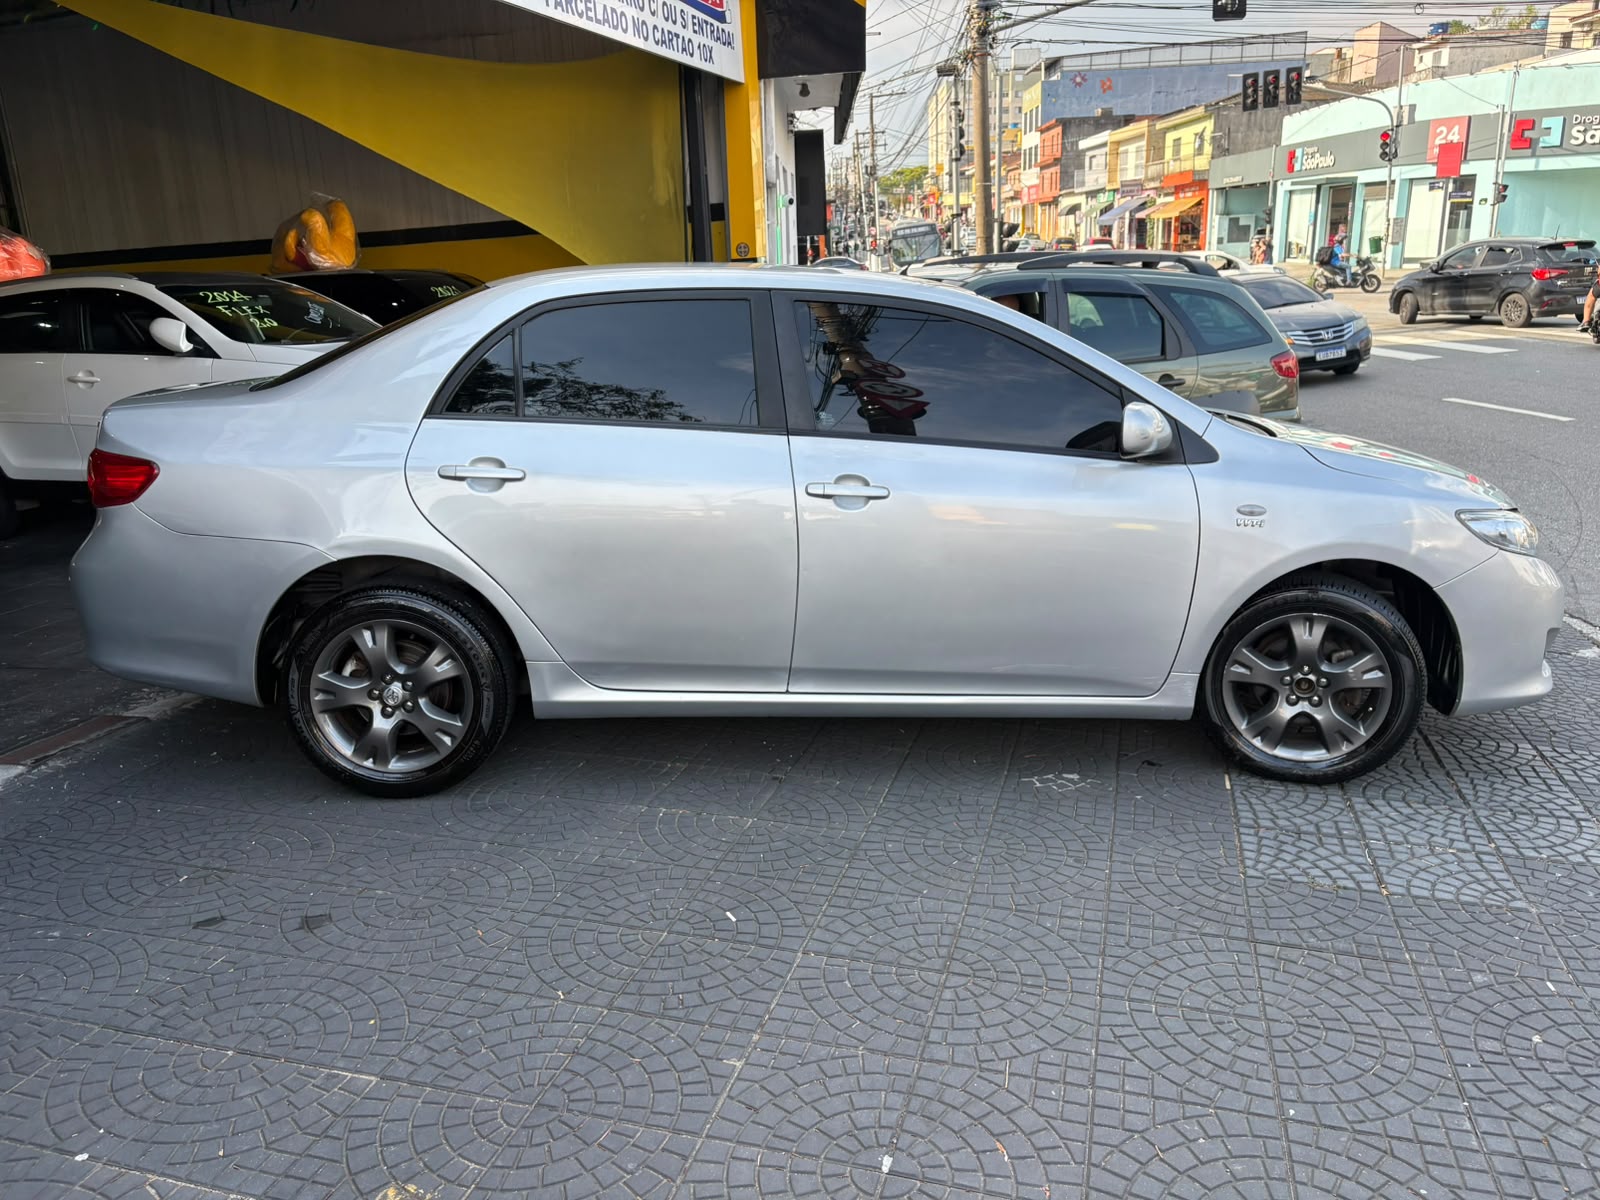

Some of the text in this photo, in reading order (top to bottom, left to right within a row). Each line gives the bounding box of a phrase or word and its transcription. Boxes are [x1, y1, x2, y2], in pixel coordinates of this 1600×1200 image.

[545, 0, 629, 34] ARCELADO
[631, 15, 649, 42] NO
[697, 41, 715, 65] 10X
[661, 0, 677, 26] OU
[691, 14, 735, 51] ENTRADA!
[1434, 125, 1461, 145] 24
[215, 305, 271, 317] FLEX
